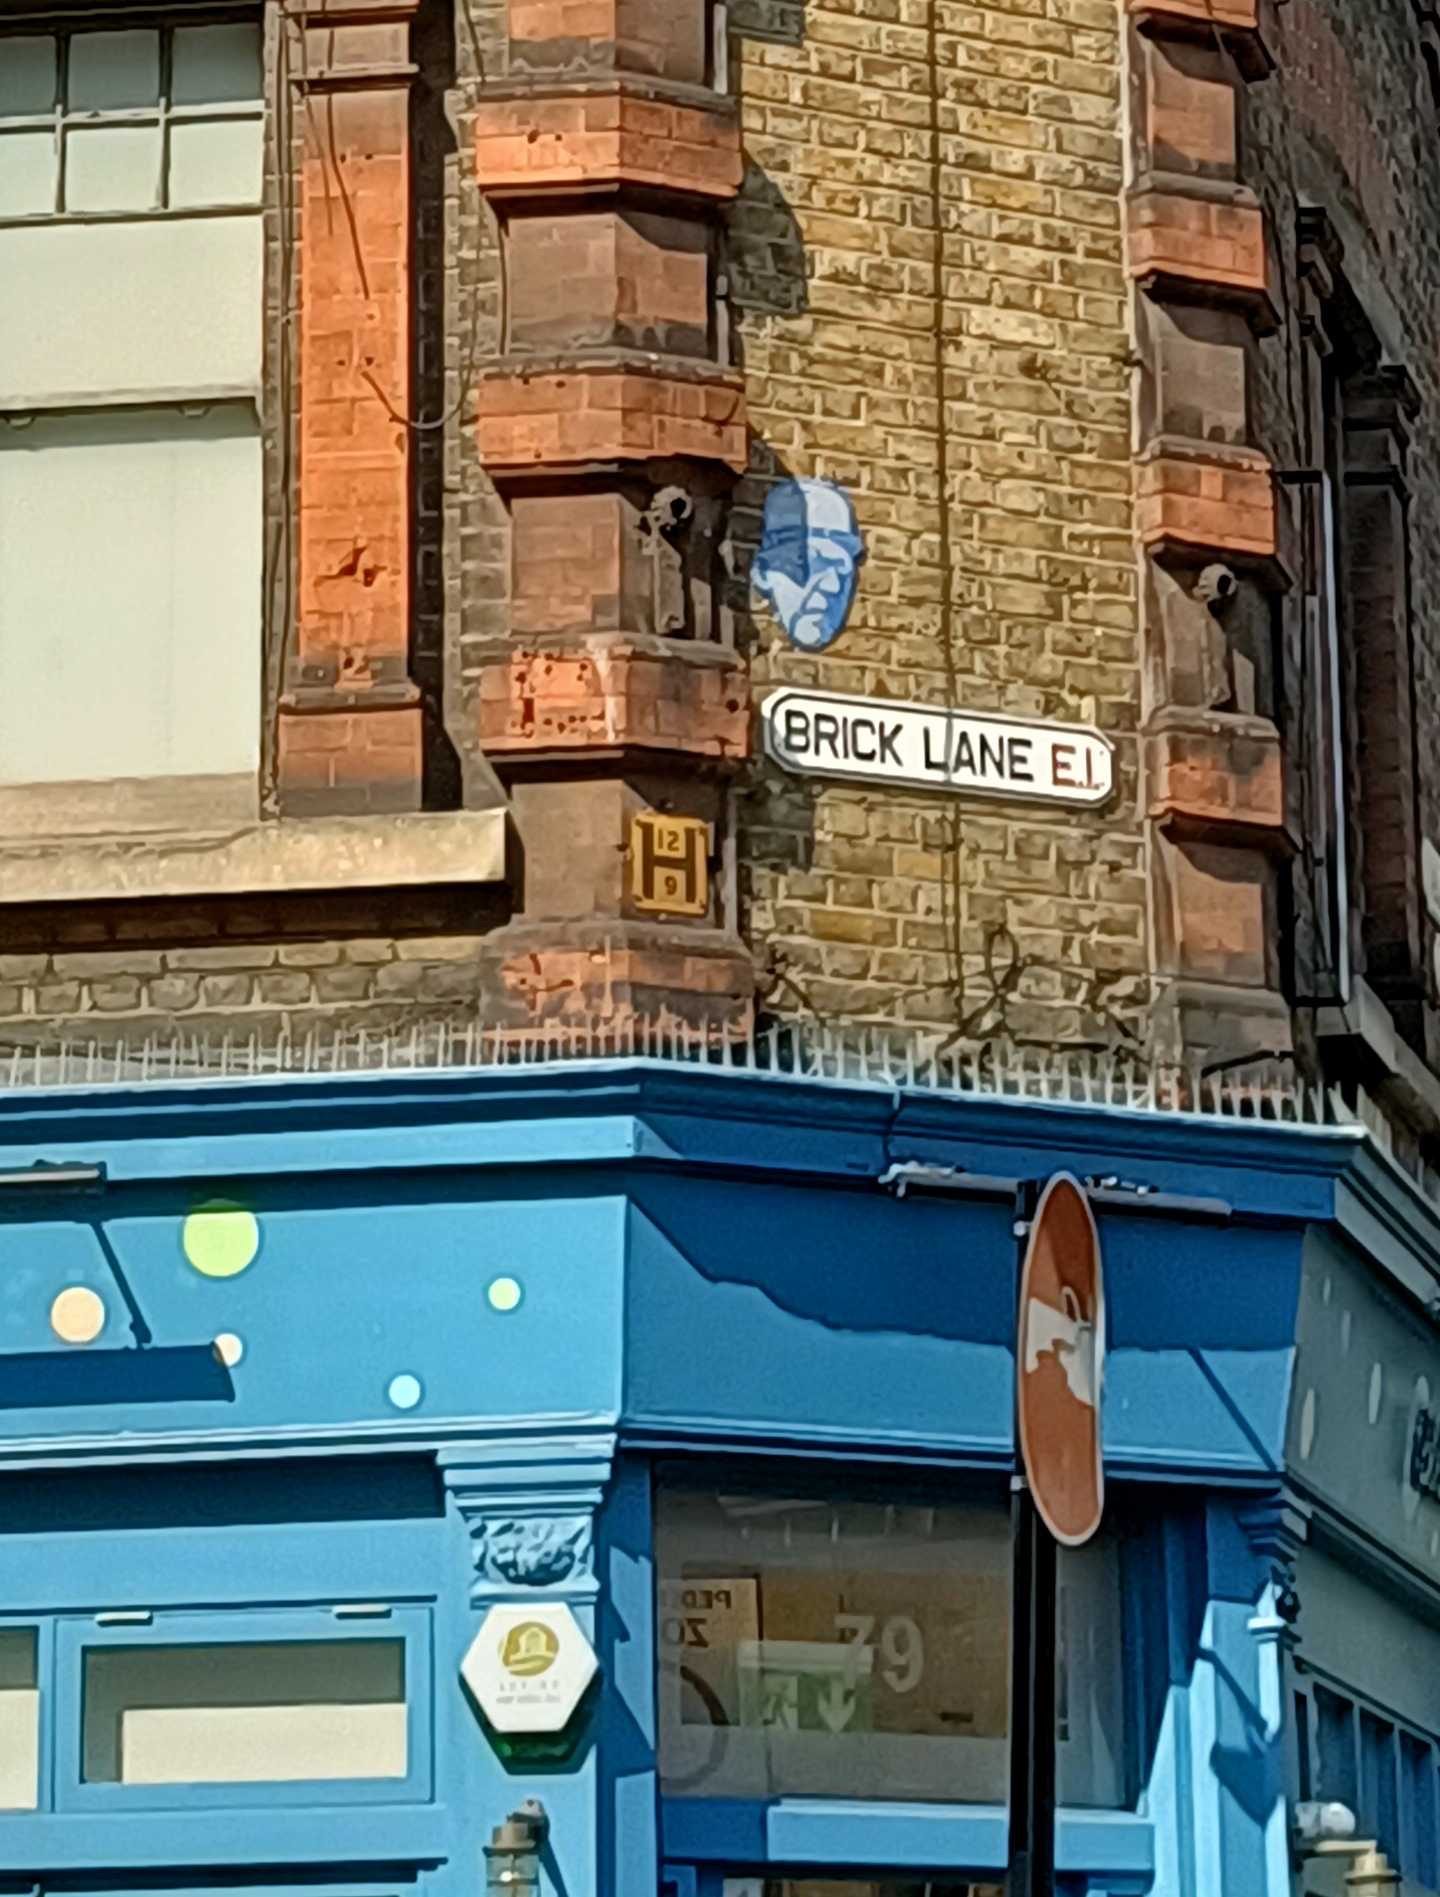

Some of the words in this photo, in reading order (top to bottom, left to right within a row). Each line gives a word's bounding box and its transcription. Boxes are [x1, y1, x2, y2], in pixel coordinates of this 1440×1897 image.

[785, 709, 903, 767] BRICK
[923, 726, 1033, 782] LANE
[641, 820, 697, 903] H
[658, 828, 680, 852] 12
[664, 875, 677, 896] 9
